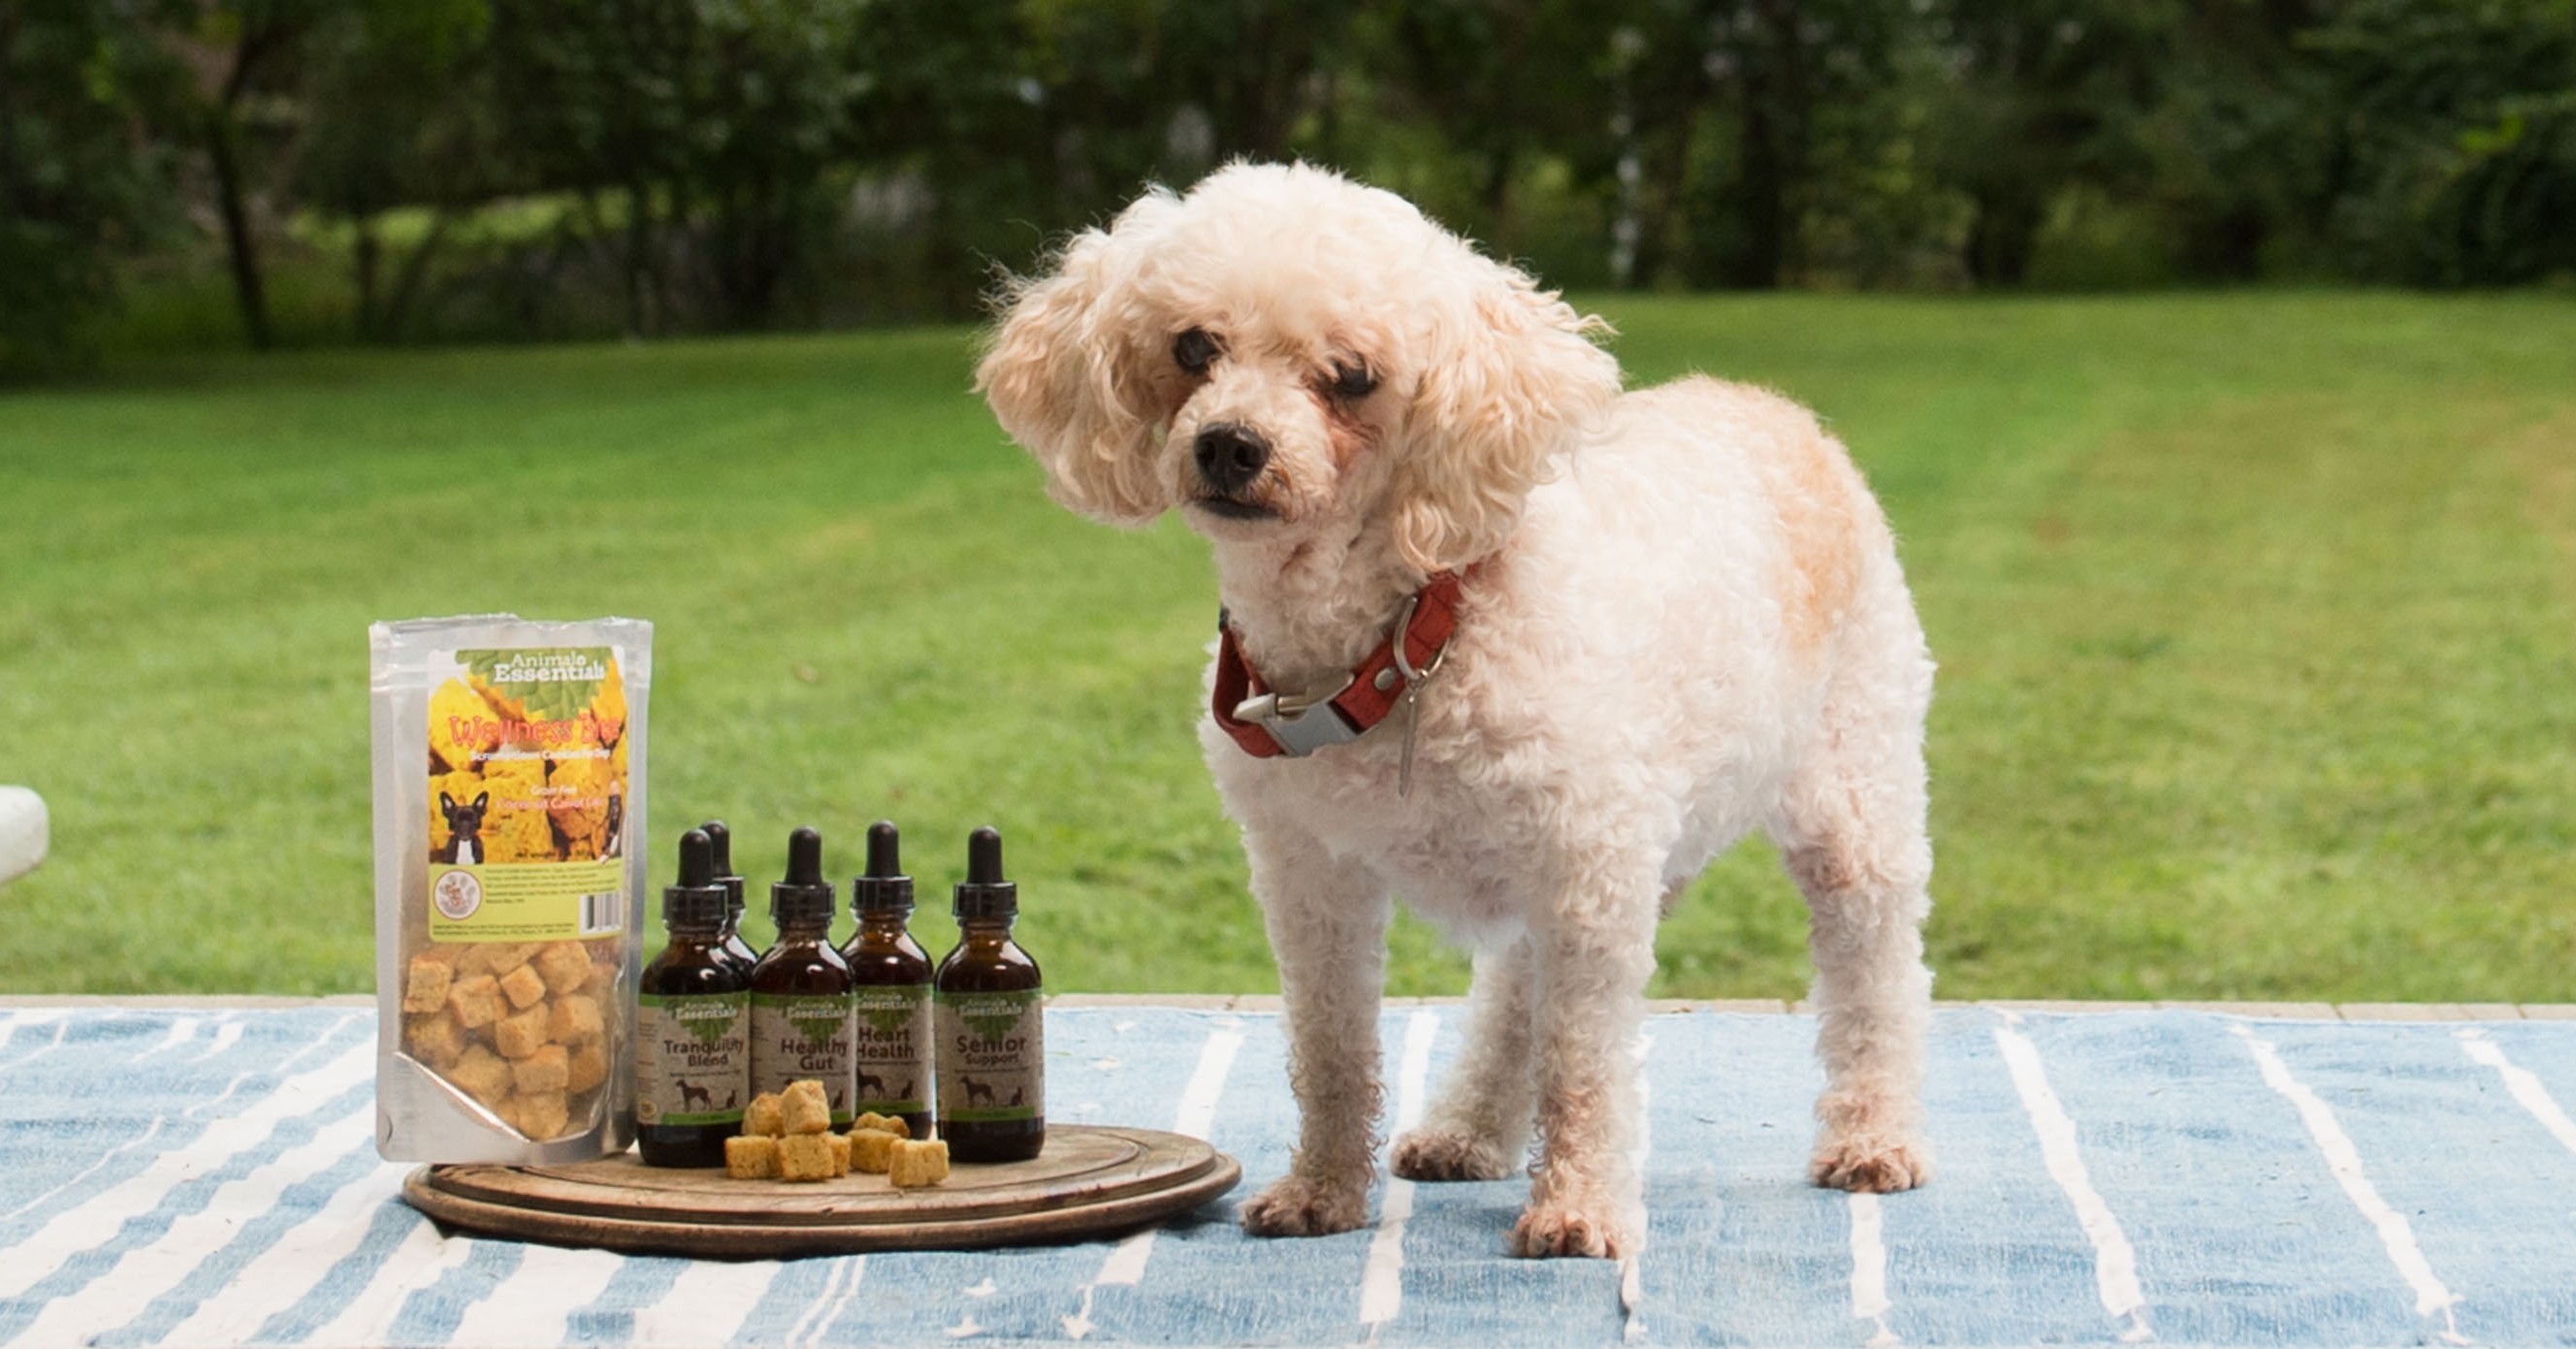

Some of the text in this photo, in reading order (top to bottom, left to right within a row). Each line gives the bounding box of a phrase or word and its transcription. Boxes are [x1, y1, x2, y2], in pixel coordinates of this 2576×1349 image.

[494, 661, 605, 683] Essentials
[449, 715, 573, 748] Wellness
[858, 1026, 912, 1044] Heart
[663, 1038, 745, 1056] Tranquility
[781, 1038, 849, 1057] Healthy
[956, 1035, 1027, 1054] Senior
[687, 1053, 729, 1068] Blend
[799, 1054, 835, 1072] Gut
[965, 1052, 1019, 1067] Support
